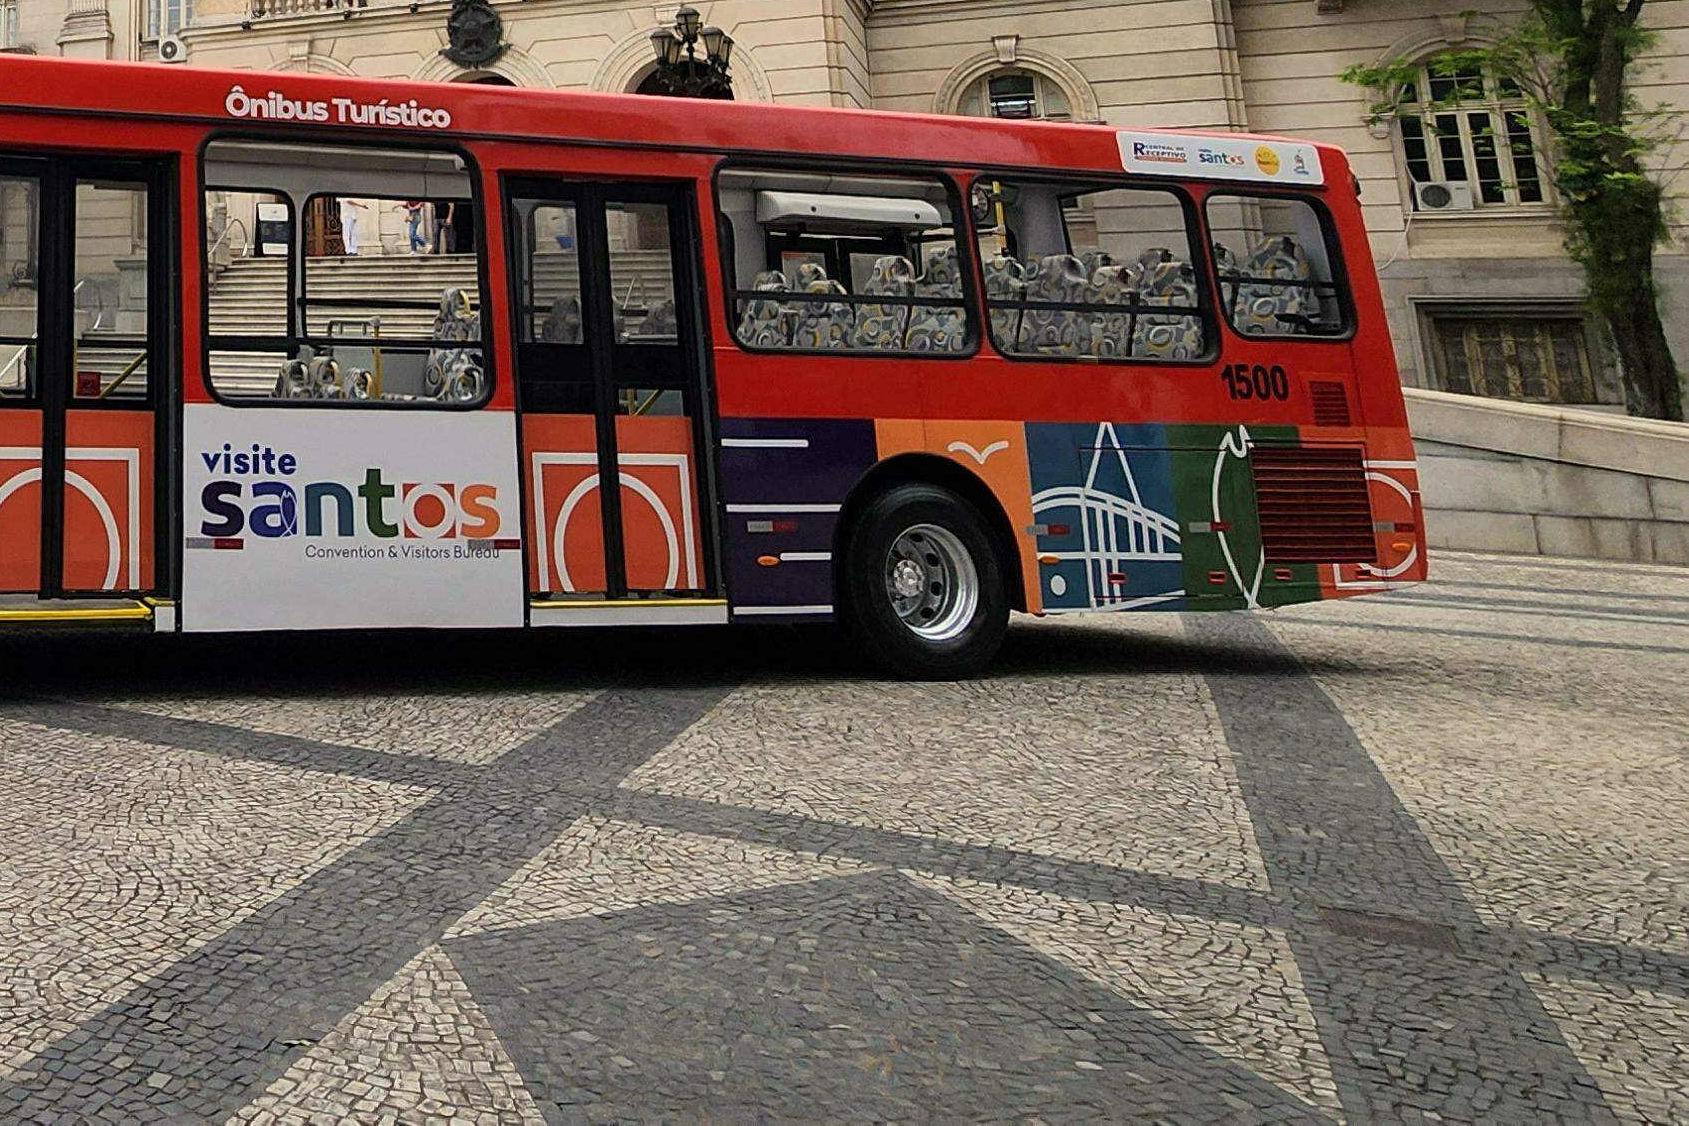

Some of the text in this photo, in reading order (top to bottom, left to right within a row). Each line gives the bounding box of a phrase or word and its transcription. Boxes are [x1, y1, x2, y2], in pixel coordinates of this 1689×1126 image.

[225, 85, 451, 129] Ônibus Turístico
[1199, 152, 1245, 165] santos
[1221, 363, 1290, 402] 1500
[201, 443, 297, 475] visite
[201, 468, 501, 539] santos
[305, 544, 500, 559] Convention & Visitors Bureau
